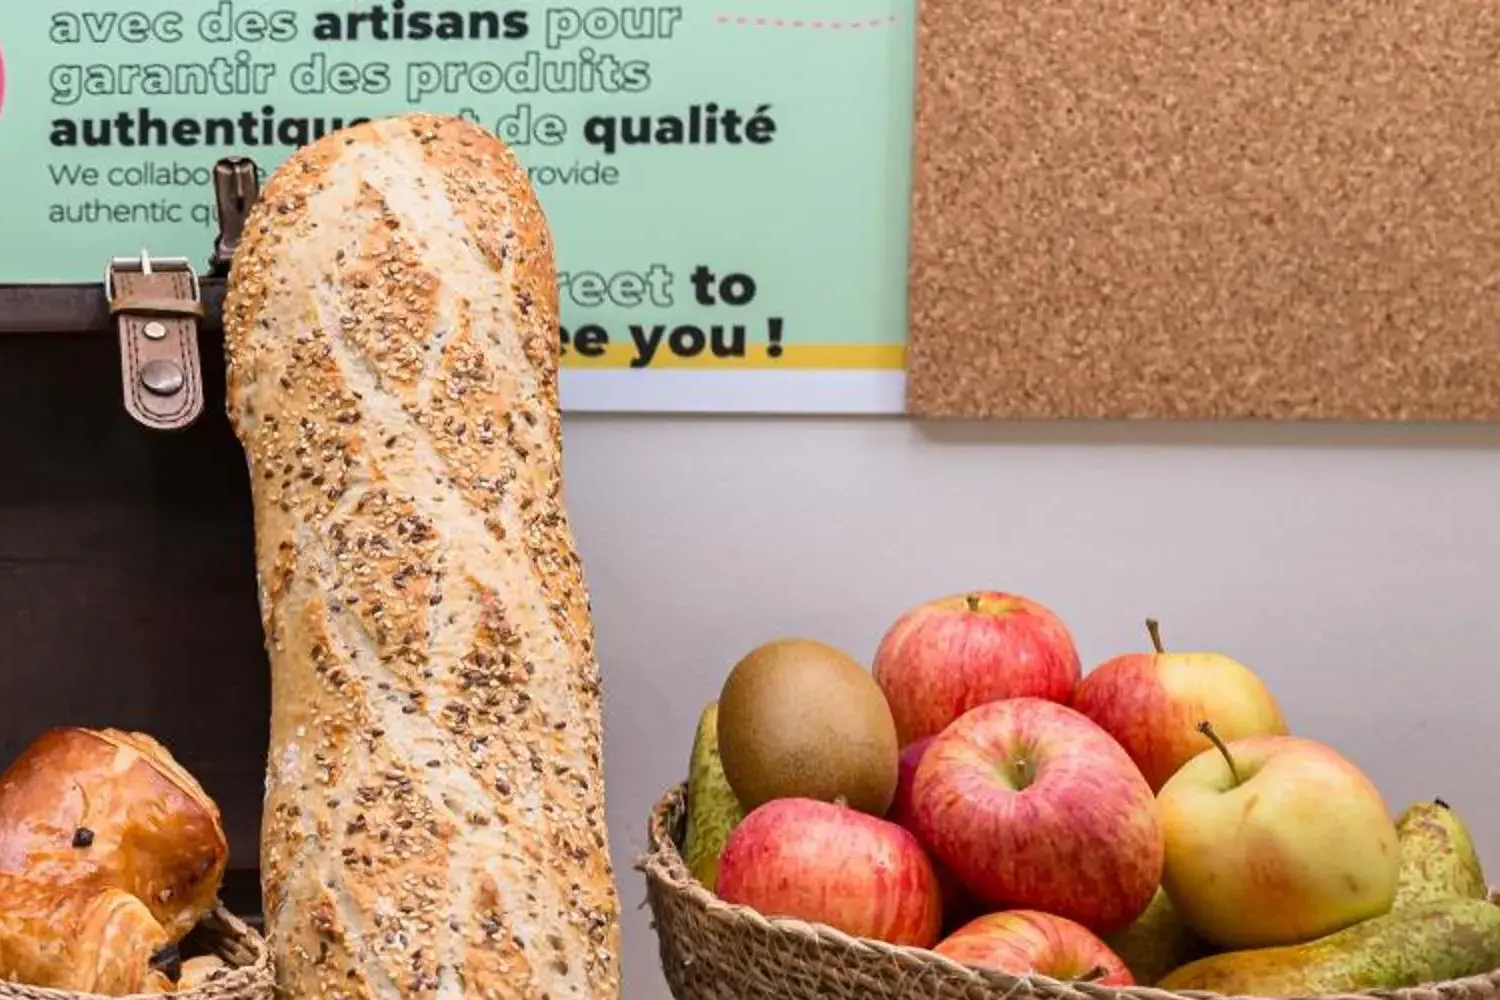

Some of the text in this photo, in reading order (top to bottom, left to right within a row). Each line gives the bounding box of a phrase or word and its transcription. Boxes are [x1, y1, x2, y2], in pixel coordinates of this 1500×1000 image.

[49, 0, 682, 49] avec des artisans pour
[49, 48, 652, 105] garantir des produits
[49, 101, 777, 154] authentiqu de qualité
[47, 163, 99, 187] We
[527, 159, 620, 186] rovide
[49, 198, 183, 224] authentic
[690, 265, 757, 306] to
[629, 324, 747, 368] you
